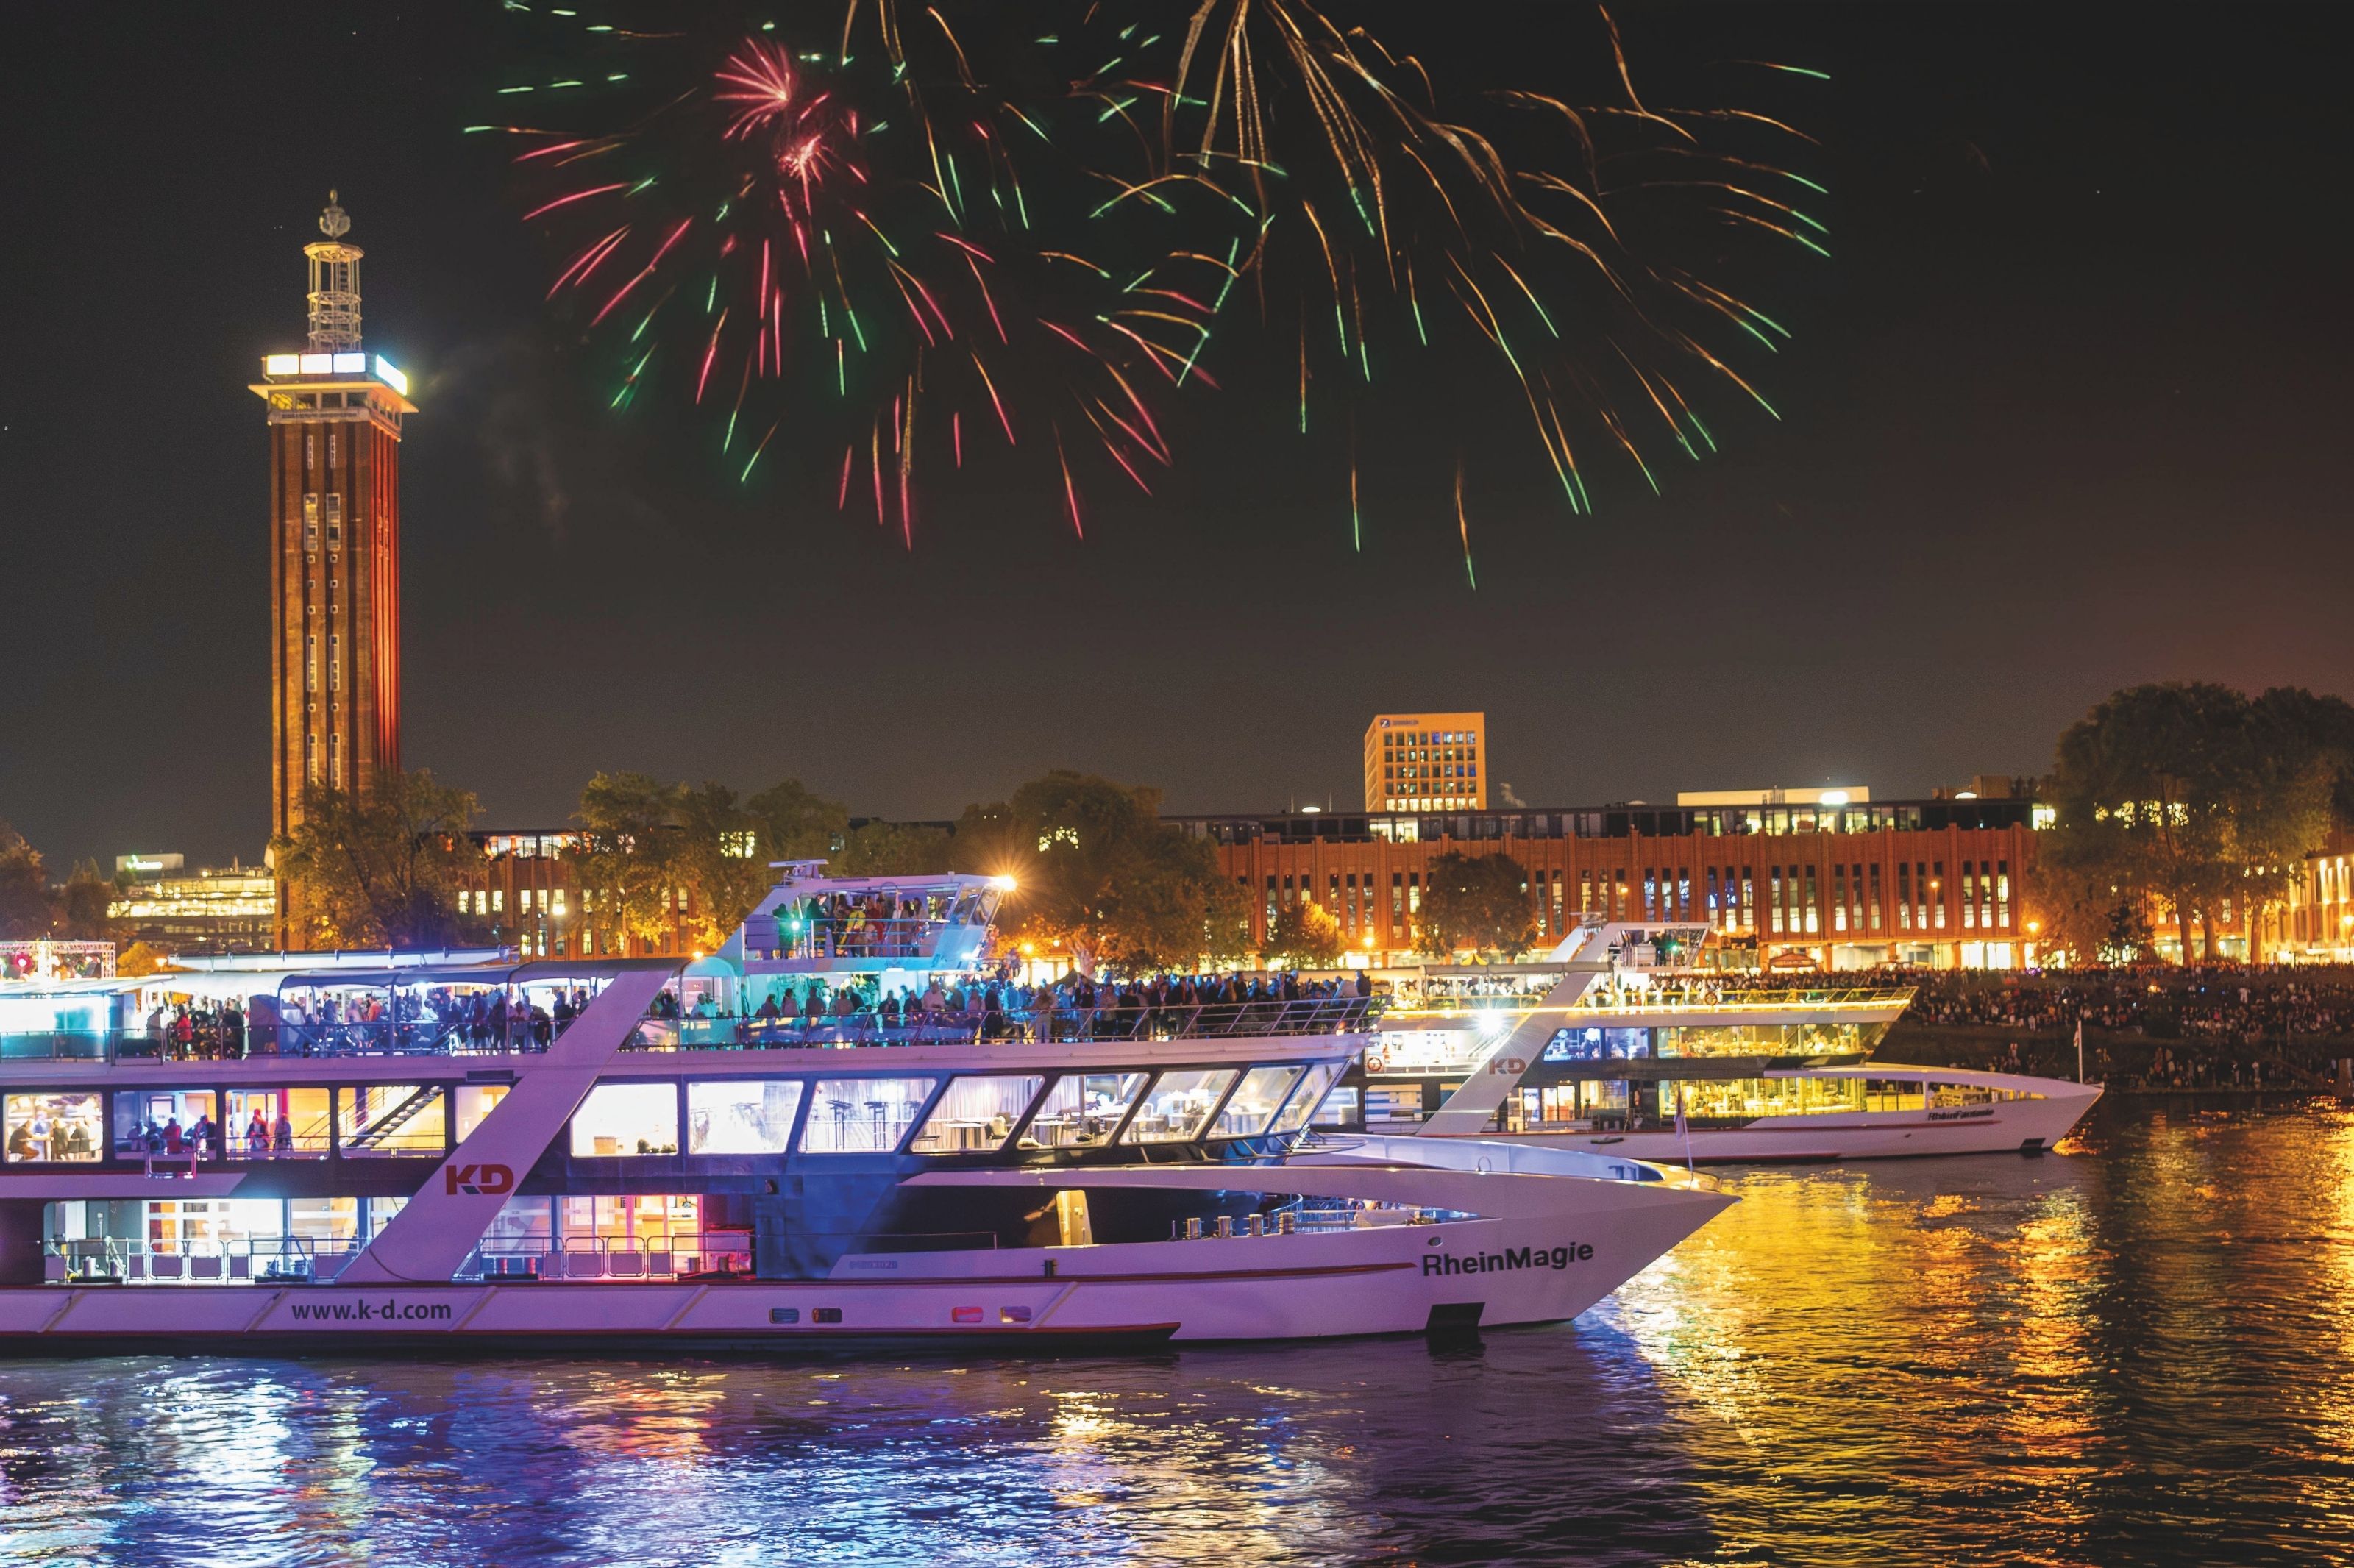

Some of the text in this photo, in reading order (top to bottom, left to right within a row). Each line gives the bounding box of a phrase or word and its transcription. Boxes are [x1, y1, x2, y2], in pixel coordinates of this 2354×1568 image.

[1489, 1058, 1526, 1075] KD
[446, 1164, 514, 1195] KD
[1423, 1241, 1594, 1276] RheinMagie
[291, 1299, 451, 1320] www.k-d.com
